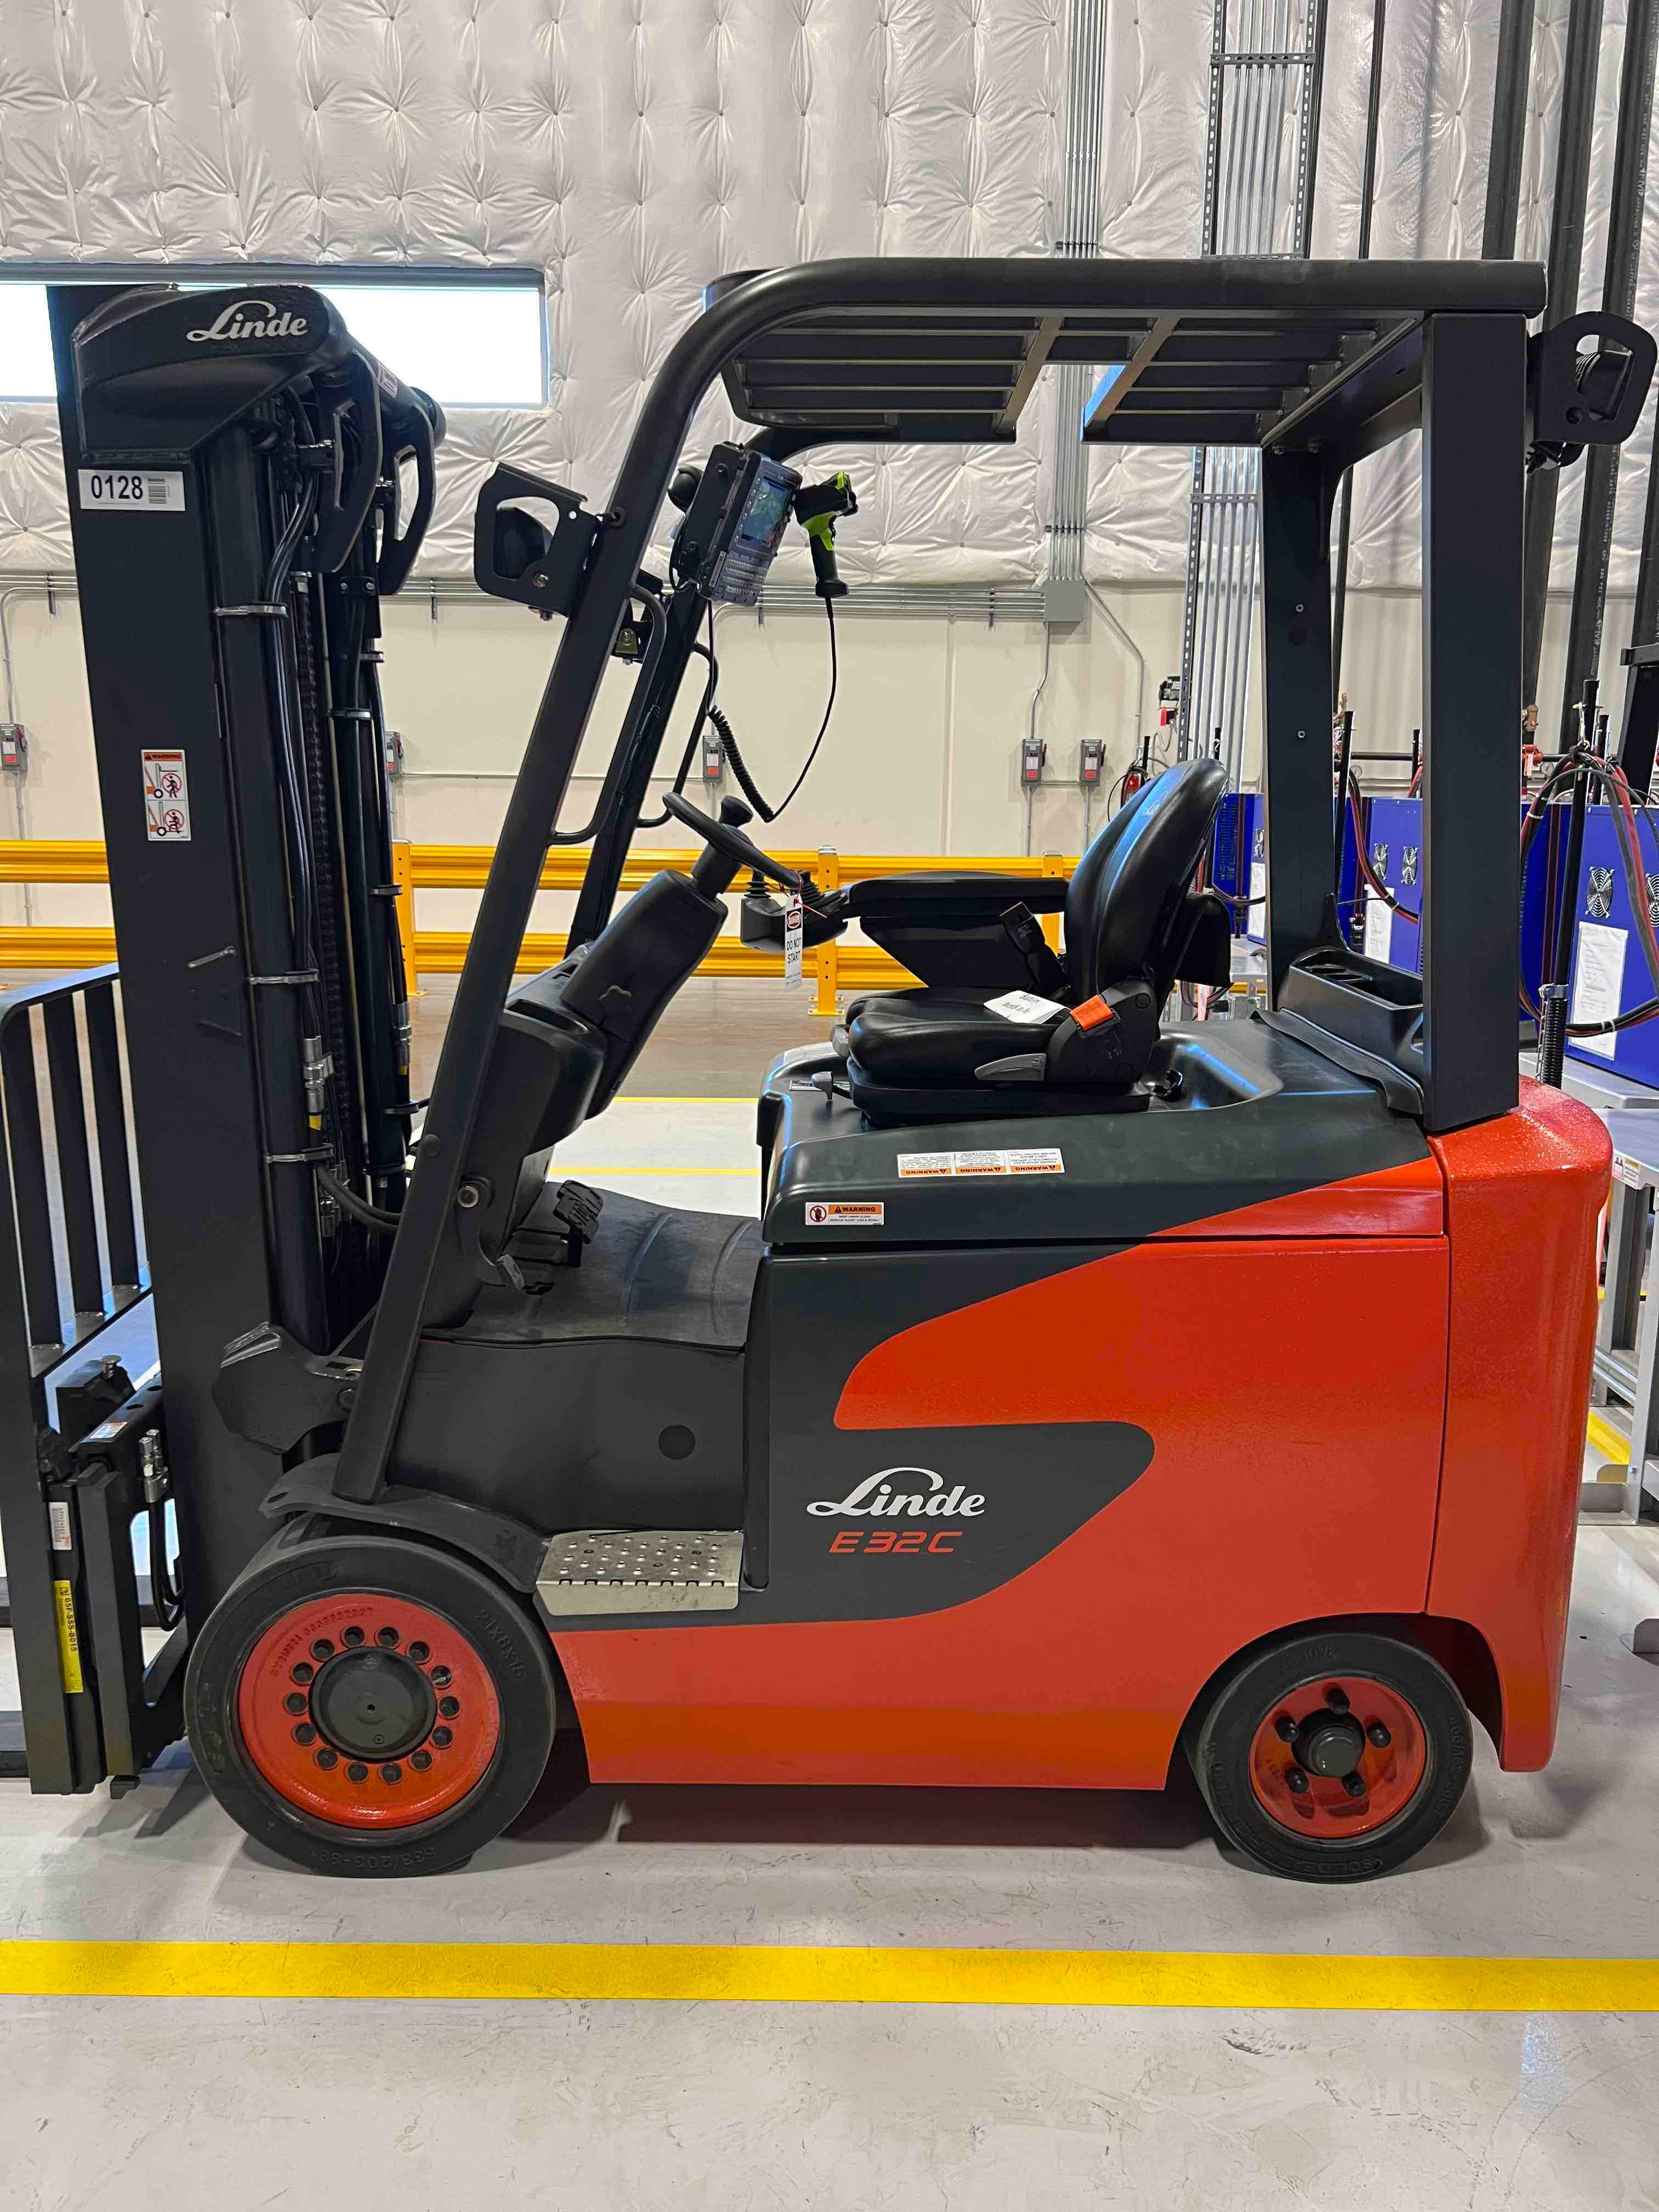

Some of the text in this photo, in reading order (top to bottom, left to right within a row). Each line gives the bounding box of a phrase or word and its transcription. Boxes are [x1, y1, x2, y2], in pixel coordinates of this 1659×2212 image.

[187, 300, 308, 341] Linde
[91, 475, 143, 500] 0128
[787, 940, 793, 951] DO
[788, 951, 800, 964] START
[806, 1466, 985, 1516] Linde
